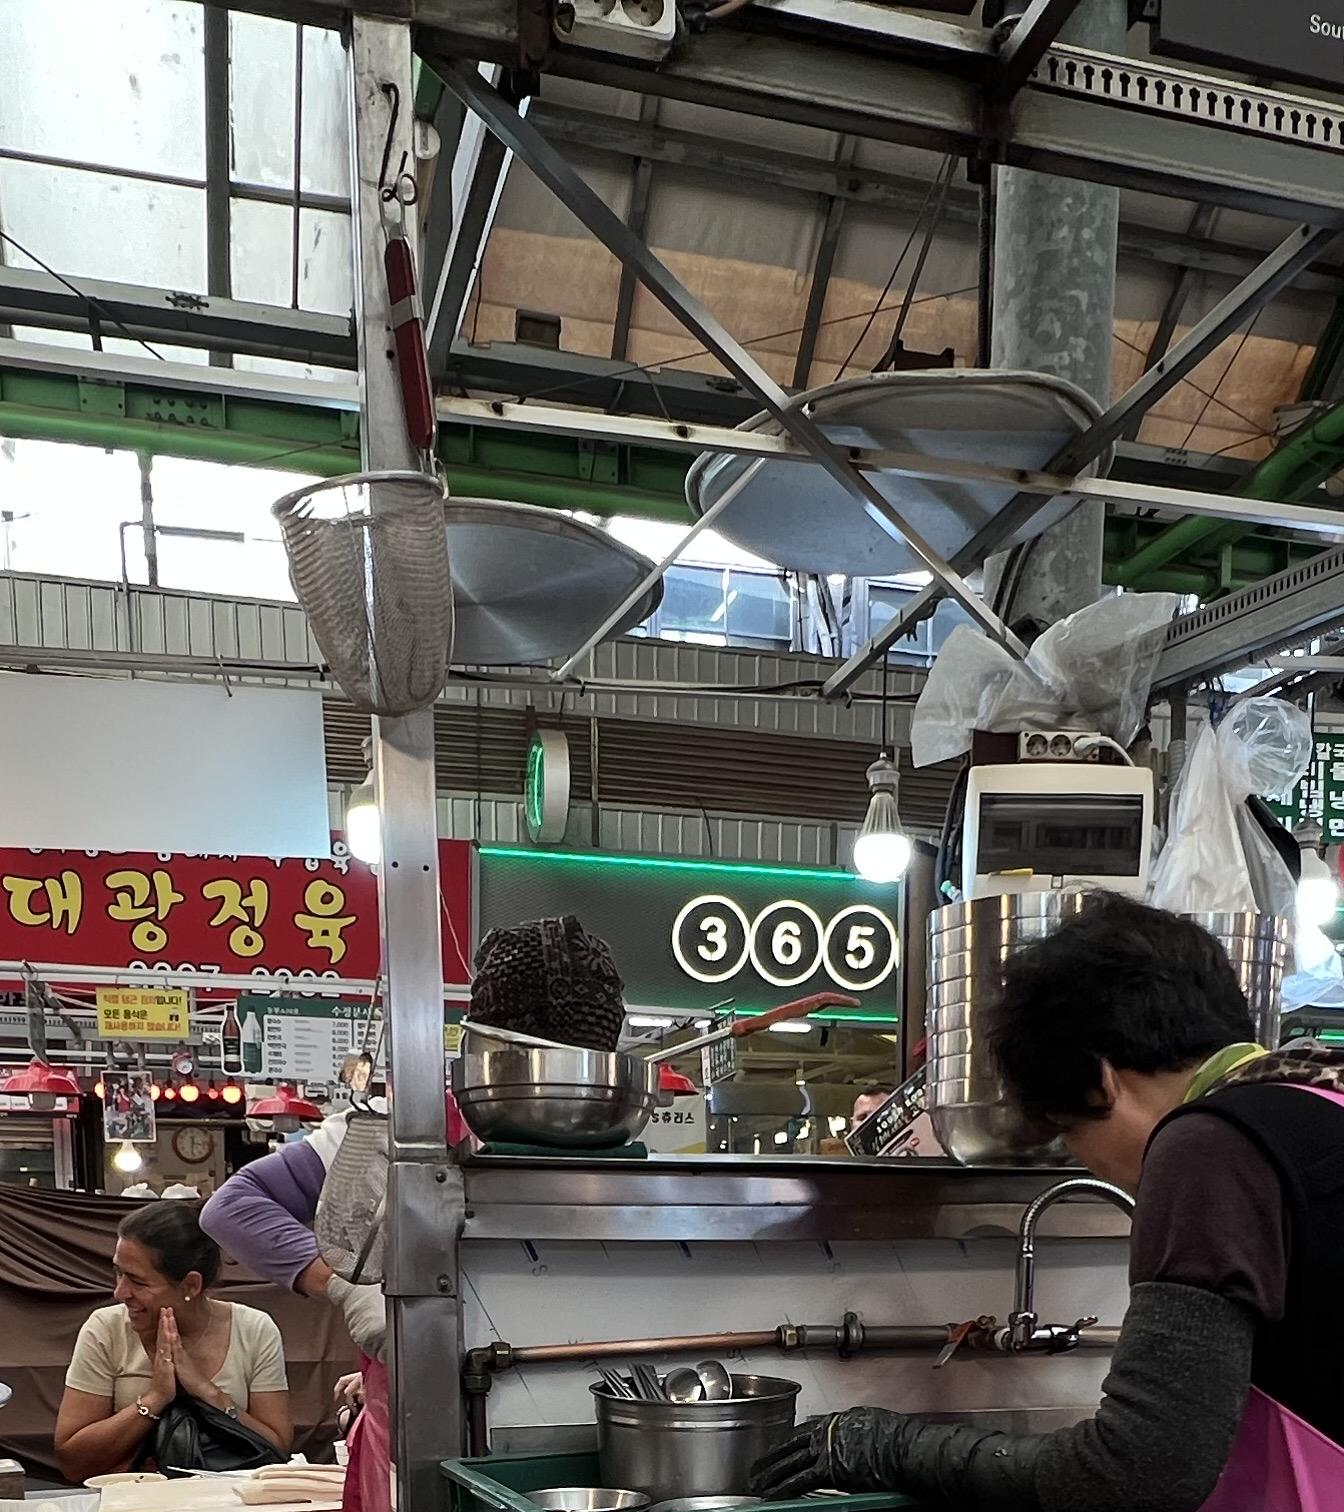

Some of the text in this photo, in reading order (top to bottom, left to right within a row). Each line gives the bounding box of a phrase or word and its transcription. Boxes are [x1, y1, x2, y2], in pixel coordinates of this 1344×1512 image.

[2, 869, 358, 964] 대광정육
[697, 915, 876, 970] 365
[103, 1008, 120, 1020] 모든
